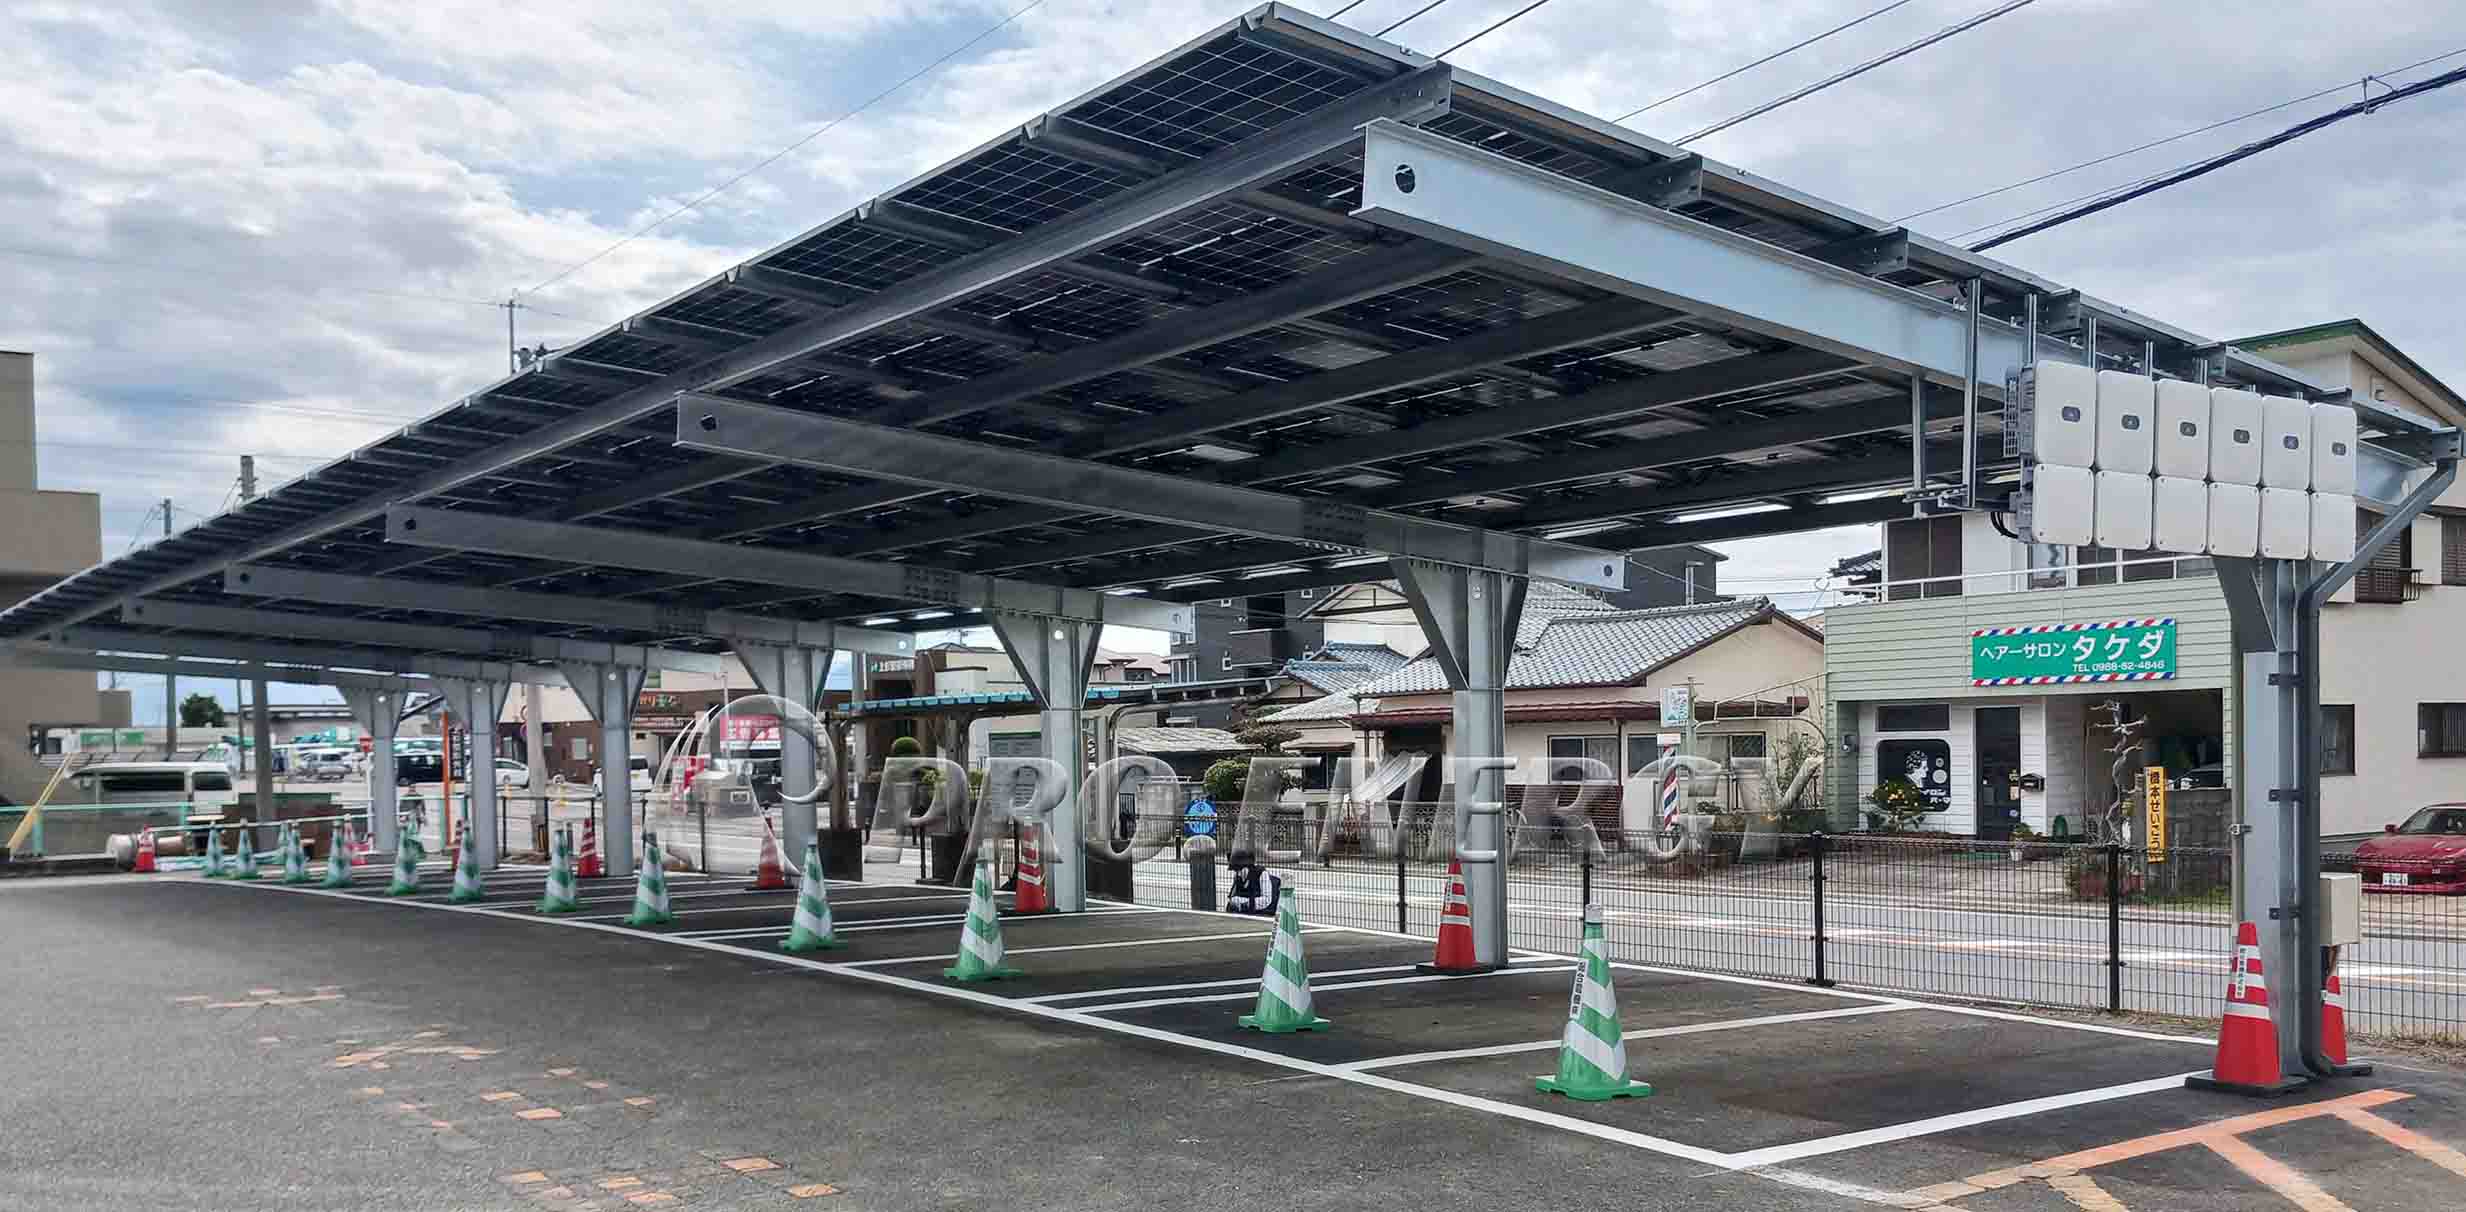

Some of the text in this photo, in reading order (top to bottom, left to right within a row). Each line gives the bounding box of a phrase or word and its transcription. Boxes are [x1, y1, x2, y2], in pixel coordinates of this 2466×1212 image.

[1979, 629, 2165, 662] ヘアーサロン タケダ
[2072, 663, 2090, 672] TEL
